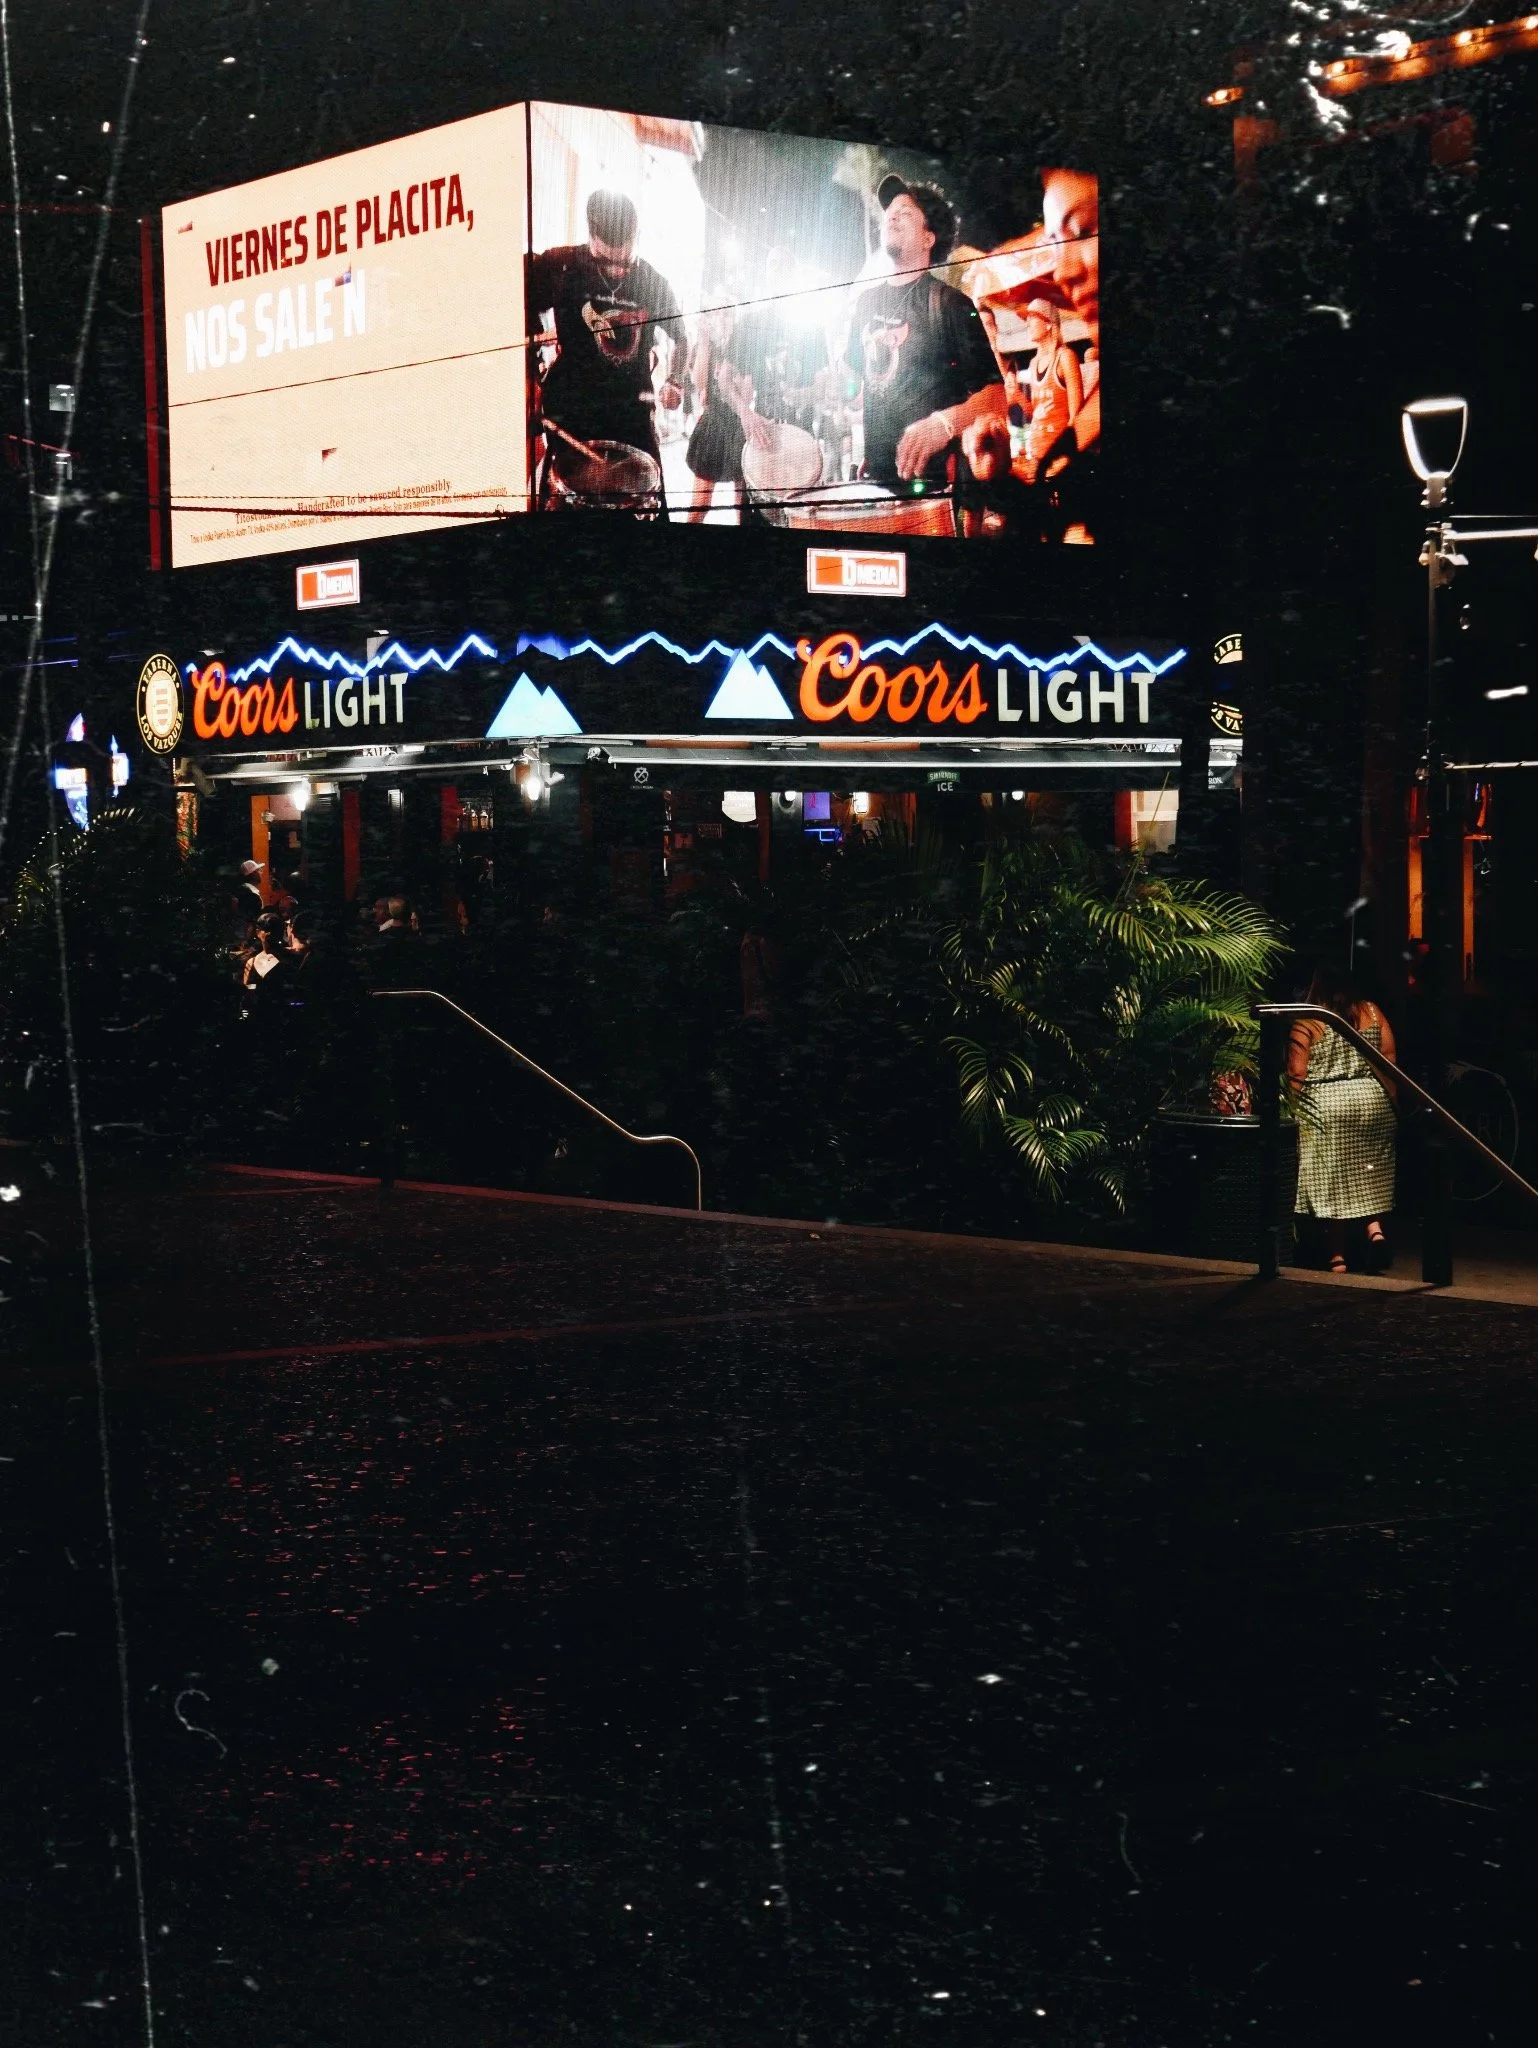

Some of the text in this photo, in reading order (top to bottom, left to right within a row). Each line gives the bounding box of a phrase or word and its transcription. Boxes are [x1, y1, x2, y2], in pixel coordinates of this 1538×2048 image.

[205, 173, 474, 287] VIERNES DE PLACITA,
[185, 299, 247, 373] NOS
[254, 278, 334, 358] SALE
[347, 496, 356, 505] to
[358, 493, 367, 504] be
[143, 658, 177, 684] TABERNA
[797, 633, 1158, 723] Coors LIGHT
[191, 661, 409, 739] Coors LIGHT
[140, 714, 153, 741] LOS
[937, 781, 954, 792] ICE
